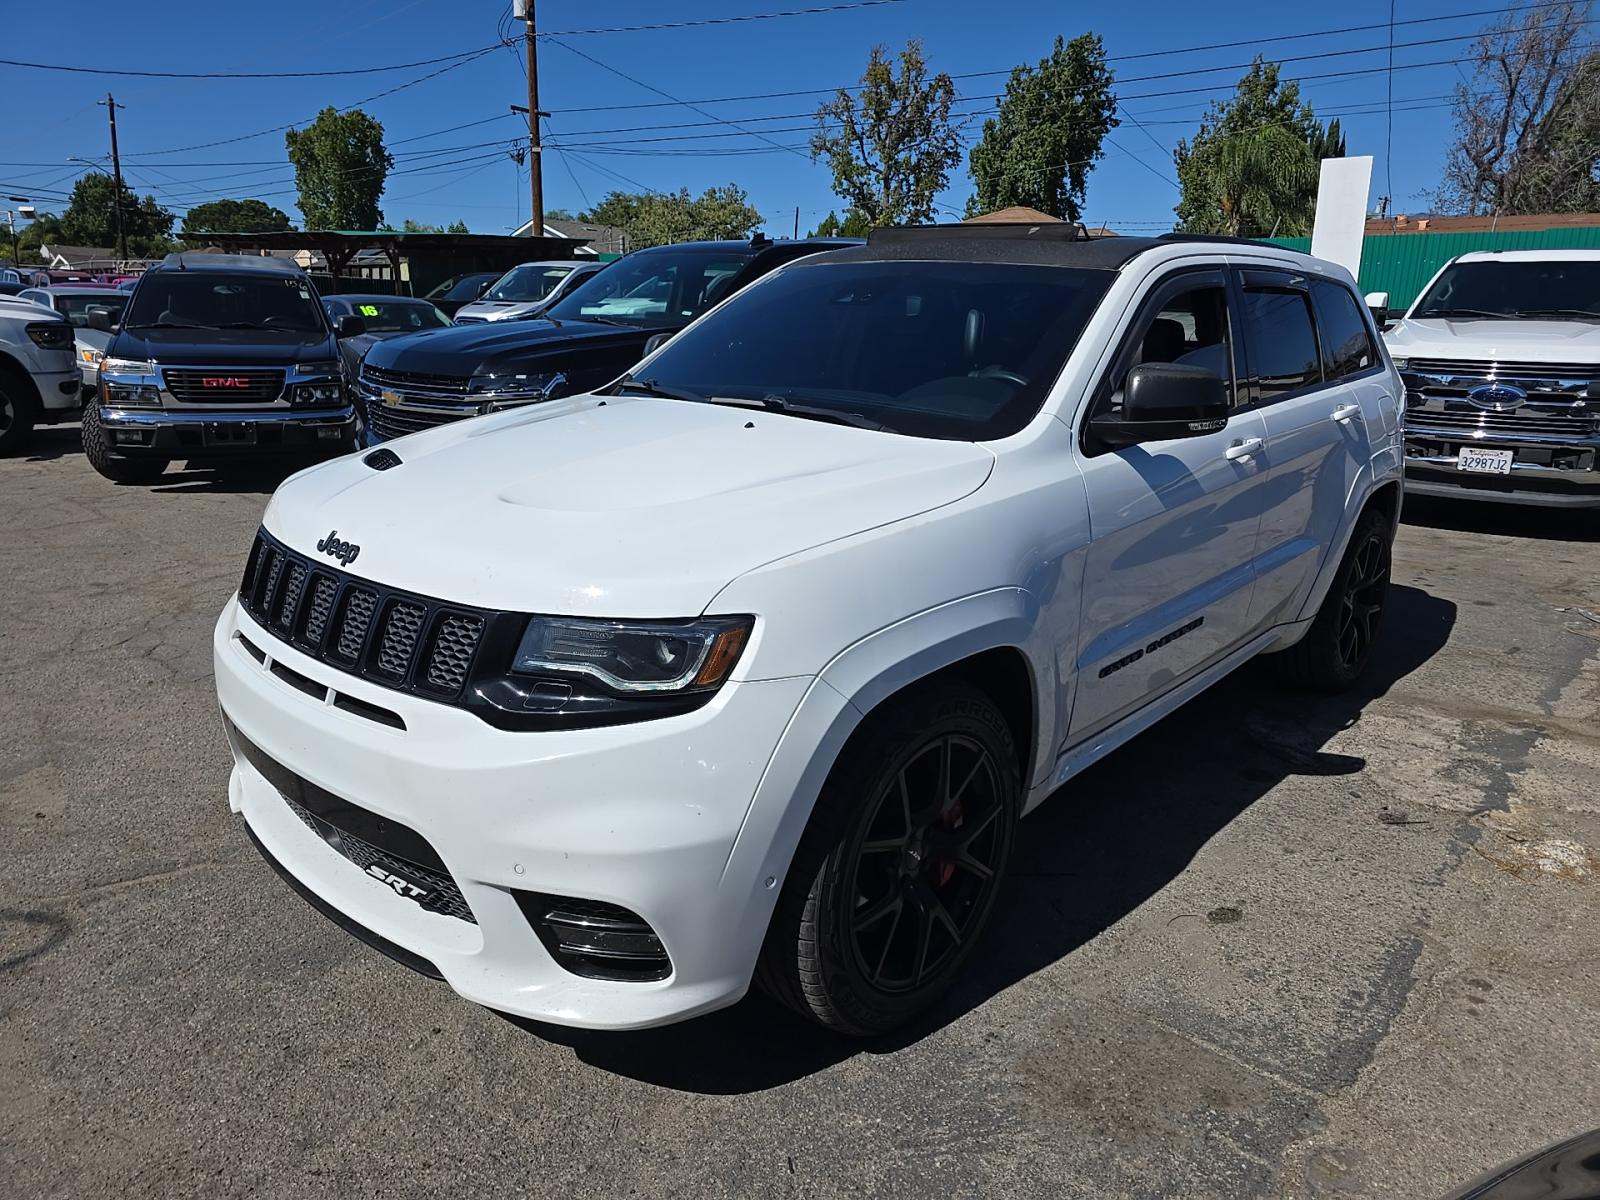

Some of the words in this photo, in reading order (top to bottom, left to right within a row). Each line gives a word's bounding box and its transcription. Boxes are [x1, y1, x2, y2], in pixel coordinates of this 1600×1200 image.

[359, 305, 379, 317] 16
[202, 377, 249, 388] GMC
[316, 530, 361, 567] Jeep
[365, 865, 427, 897] SRT
